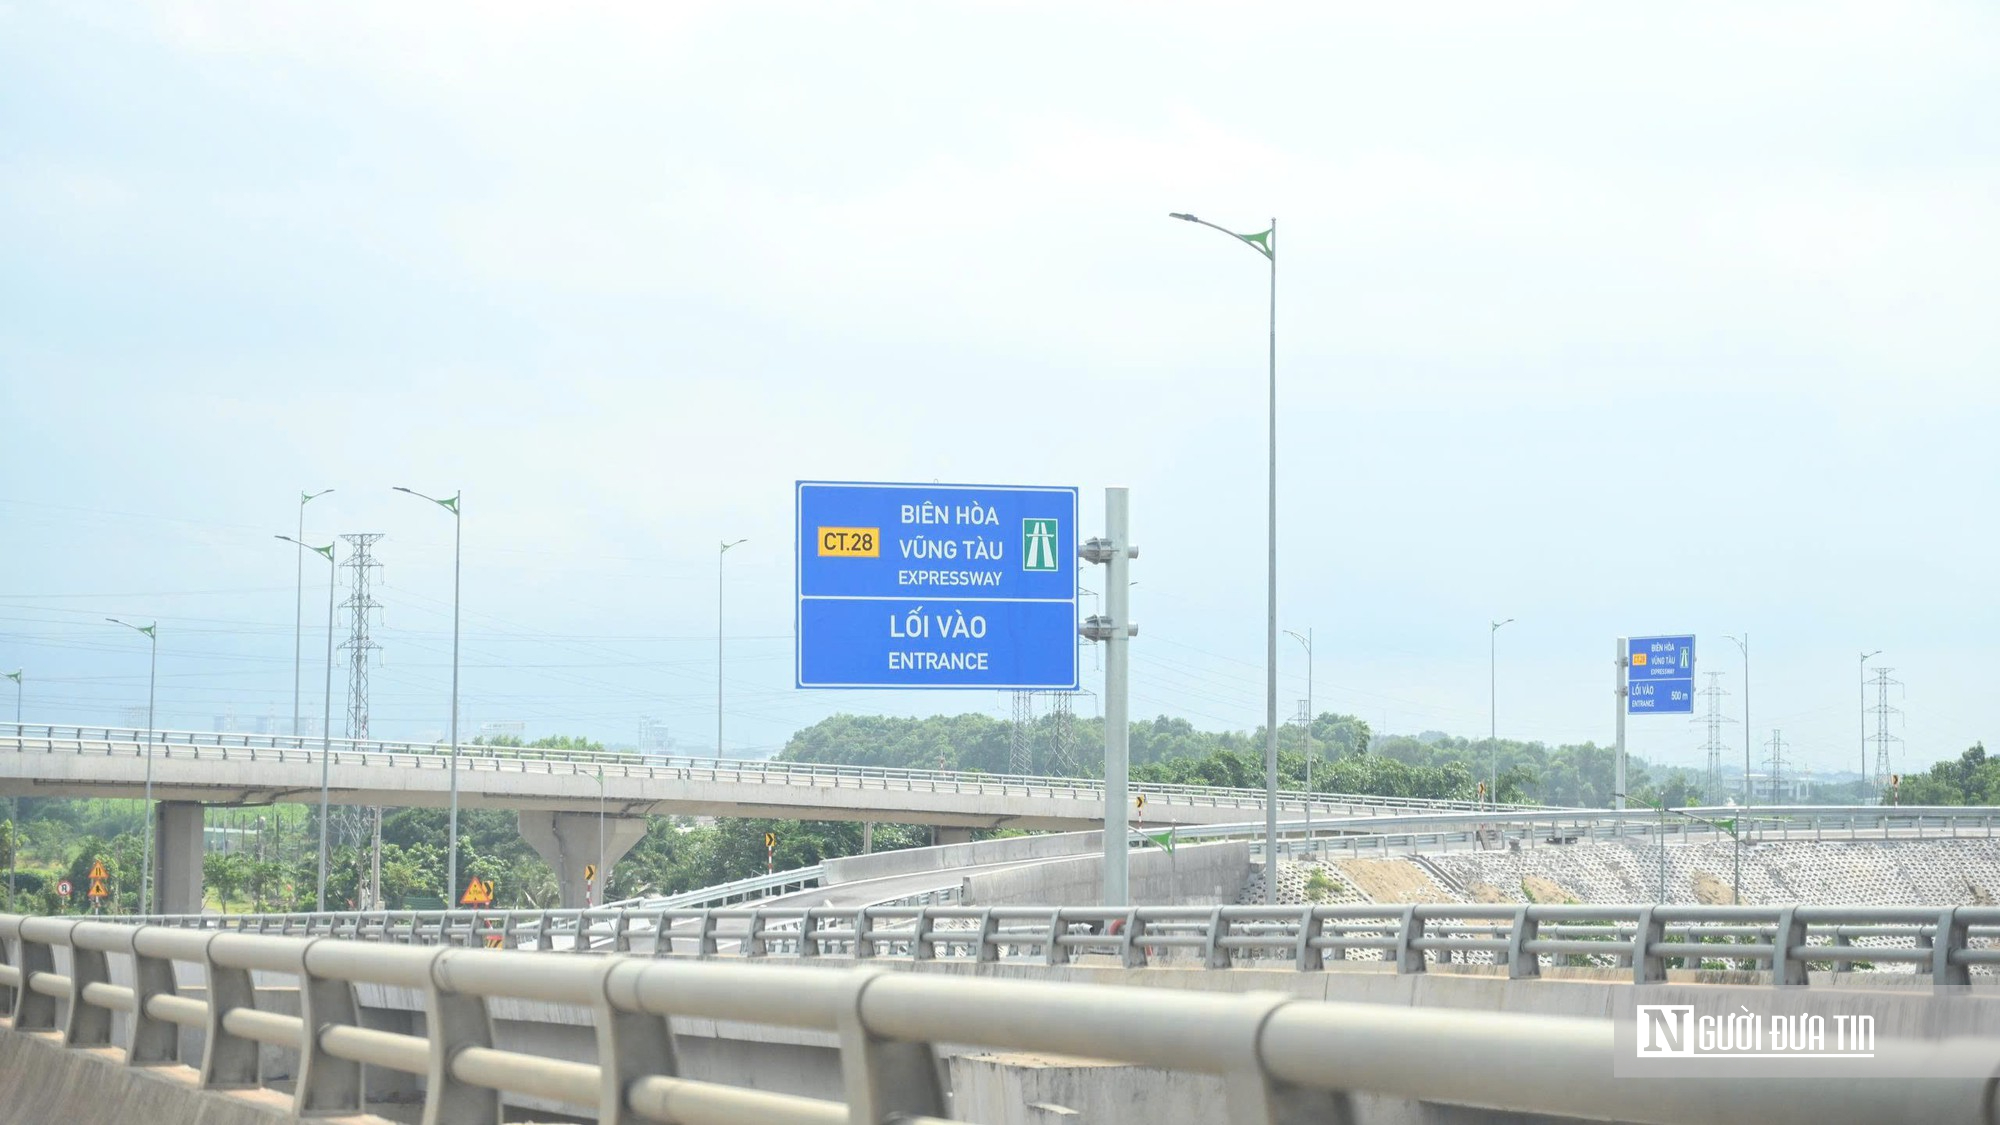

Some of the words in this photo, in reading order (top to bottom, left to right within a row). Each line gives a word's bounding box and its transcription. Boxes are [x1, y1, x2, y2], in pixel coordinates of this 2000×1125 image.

[901, 500, 949, 525] BIÊN
[955, 500, 1000, 525] HÒA
[823, 532, 873, 552] CT.28
[899, 535, 958, 560] VŨNG
[963, 535, 1003, 560] TÀU
[898, 570, 1003, 586] EXPRESSWAY
[890, 605, 929, 638] LỐI
[936, 609, 987, 639] VÀO
[888, 651, 989, 670] ENTRANCE
[1632, 683, 1641, 696] LỐI
[1642, 684, 1654, 695] VÀO
[1671, 691, 1681, 700] 500
[1632, 699, 1655, 707] ENTRANCE
